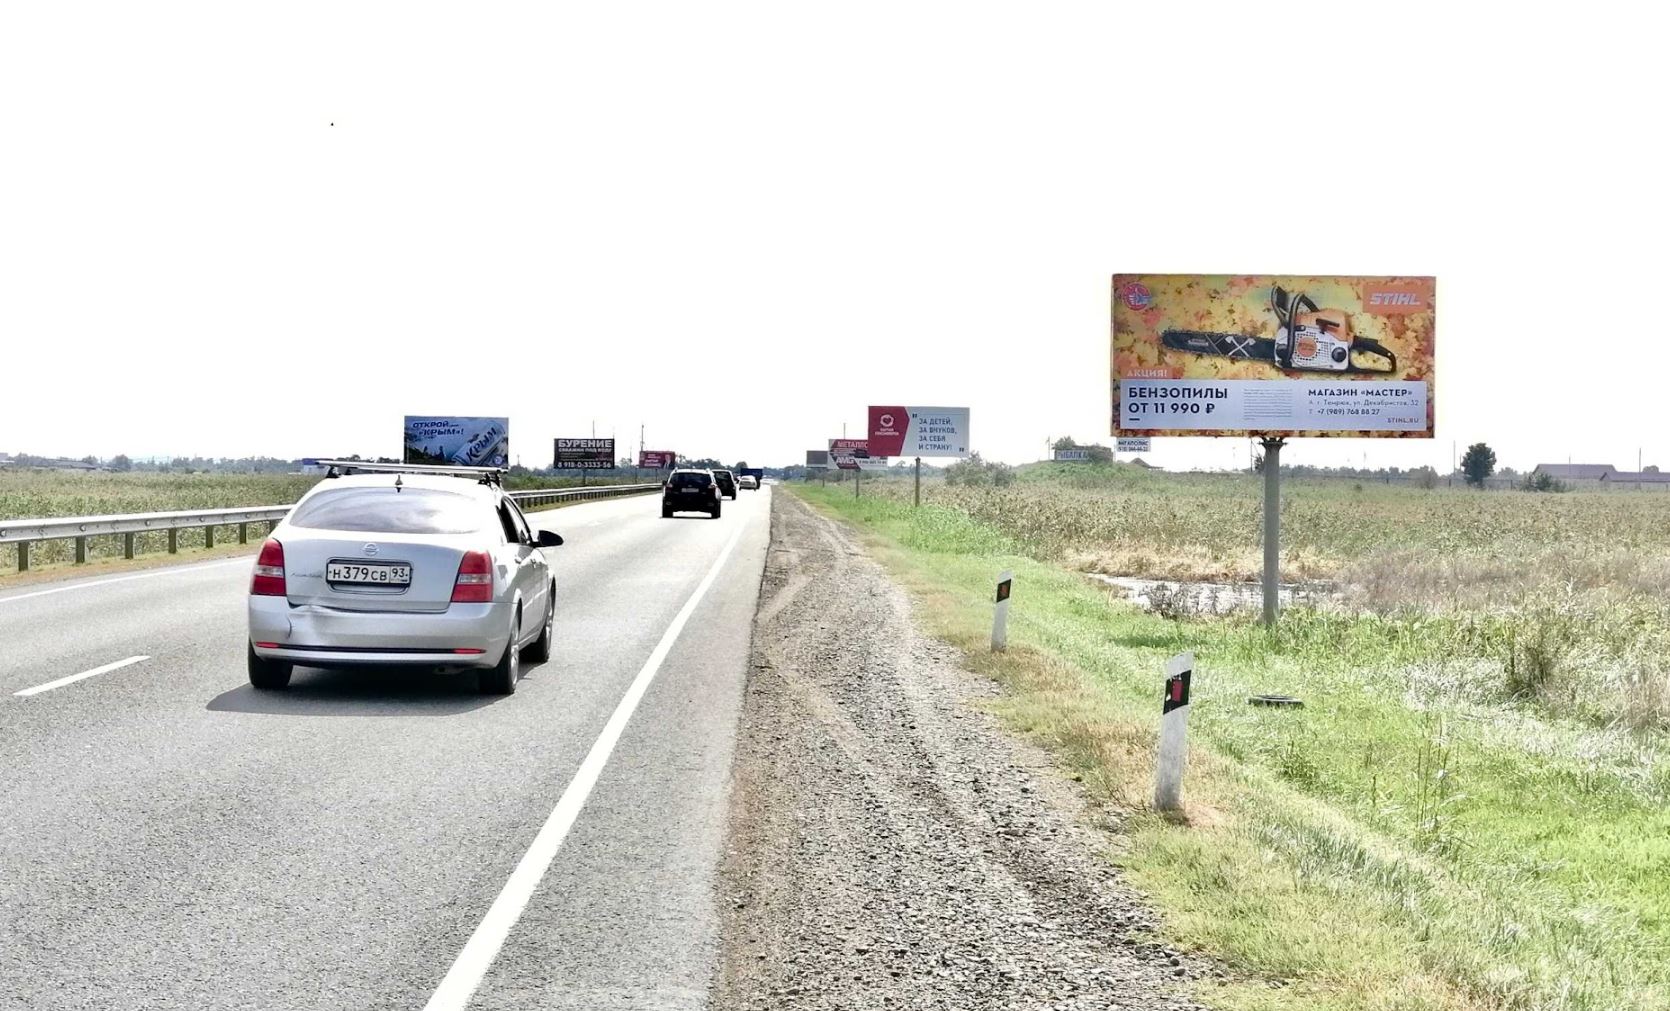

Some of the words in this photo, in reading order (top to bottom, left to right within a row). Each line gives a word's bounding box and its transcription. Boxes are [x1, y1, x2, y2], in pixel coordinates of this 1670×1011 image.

[1370, 293, 1421, 305] STIHL
[1127, 369, 1168, 378] АКЦИЯ!
[1128, 387, 1228, 399] БЕНЗОПИЛЫ
[1308, 389, 1358, 397] МАГАЗИН
[1360, 389, 1413, 397] «МАСТЕР»
[1128, 403, 1149, 414] ОТ
[1154, 403, 1165, 414] 11
[1170, 403, 1201, 414] 990
[558, 440, 612, 448] БУРЕНИЕ
